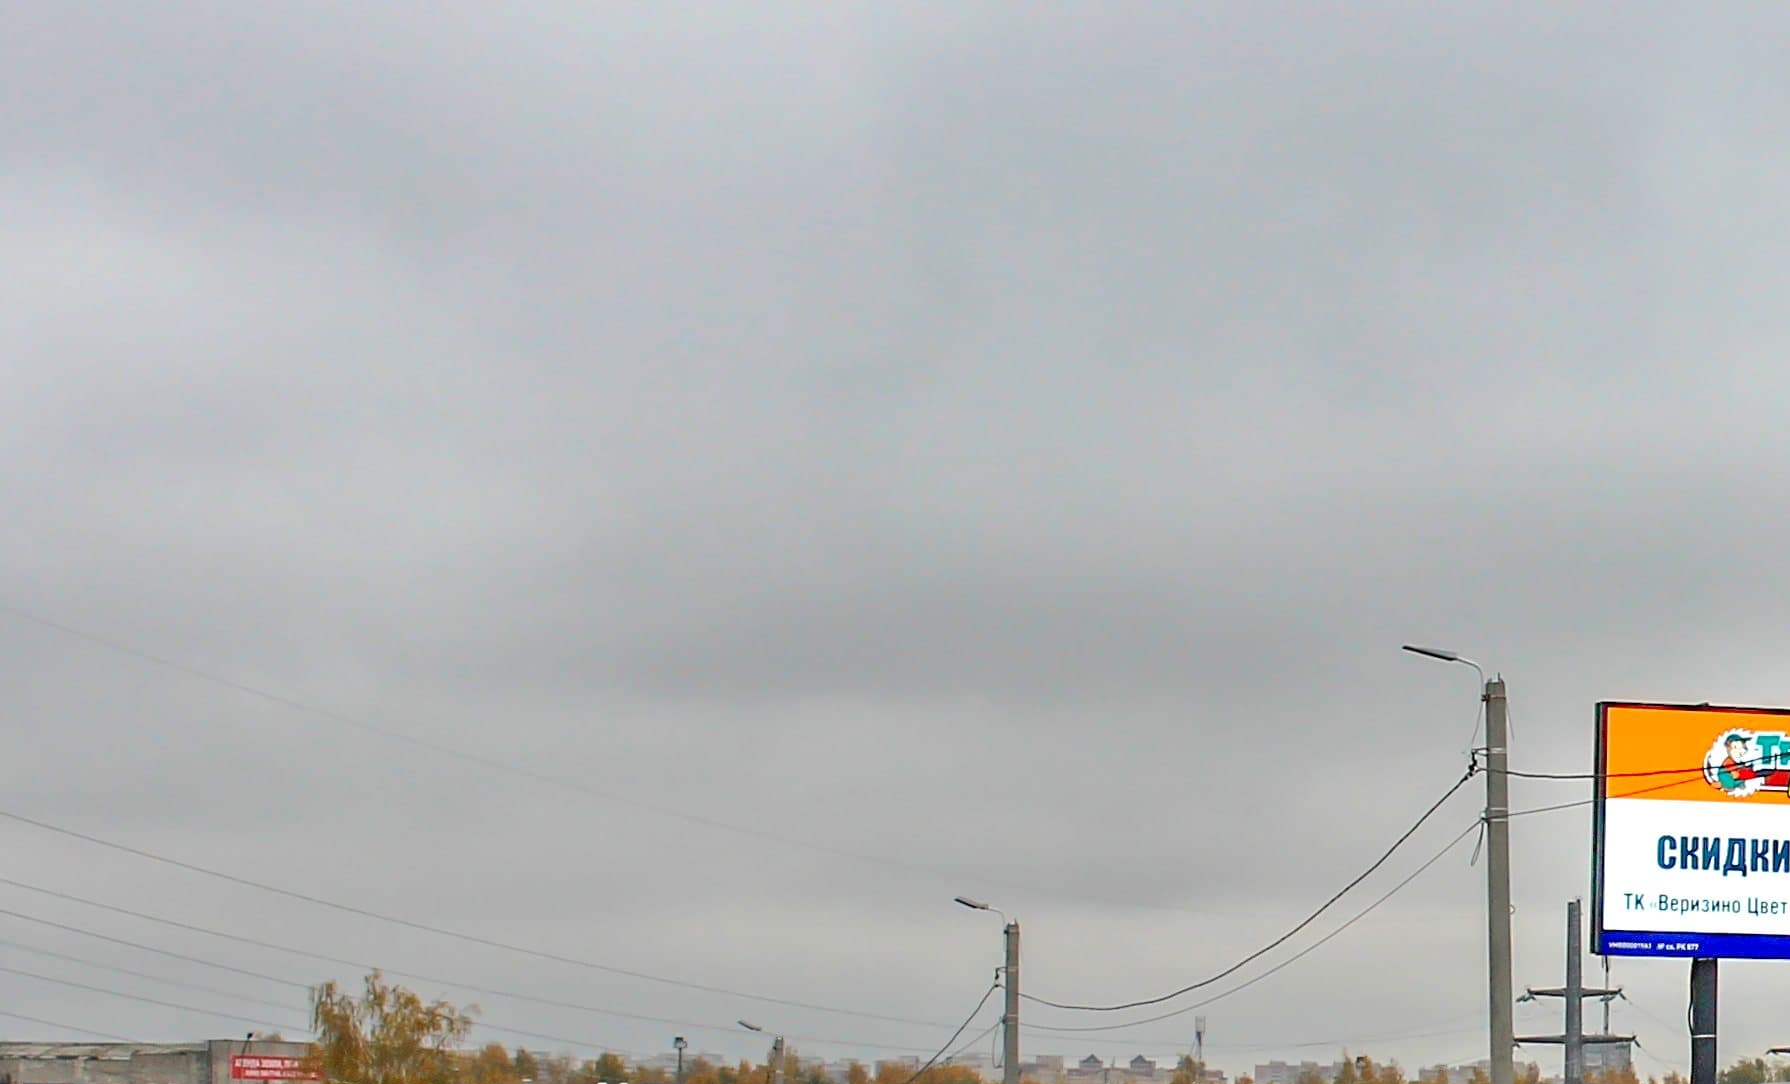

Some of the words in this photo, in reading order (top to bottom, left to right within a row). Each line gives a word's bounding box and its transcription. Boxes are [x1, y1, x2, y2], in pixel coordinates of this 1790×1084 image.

[1656, 835, 1790, 877] СКИДКИ
[1623, 893, 1645, 911] ТК
[1747, 897, 1788, 916] Цвет
